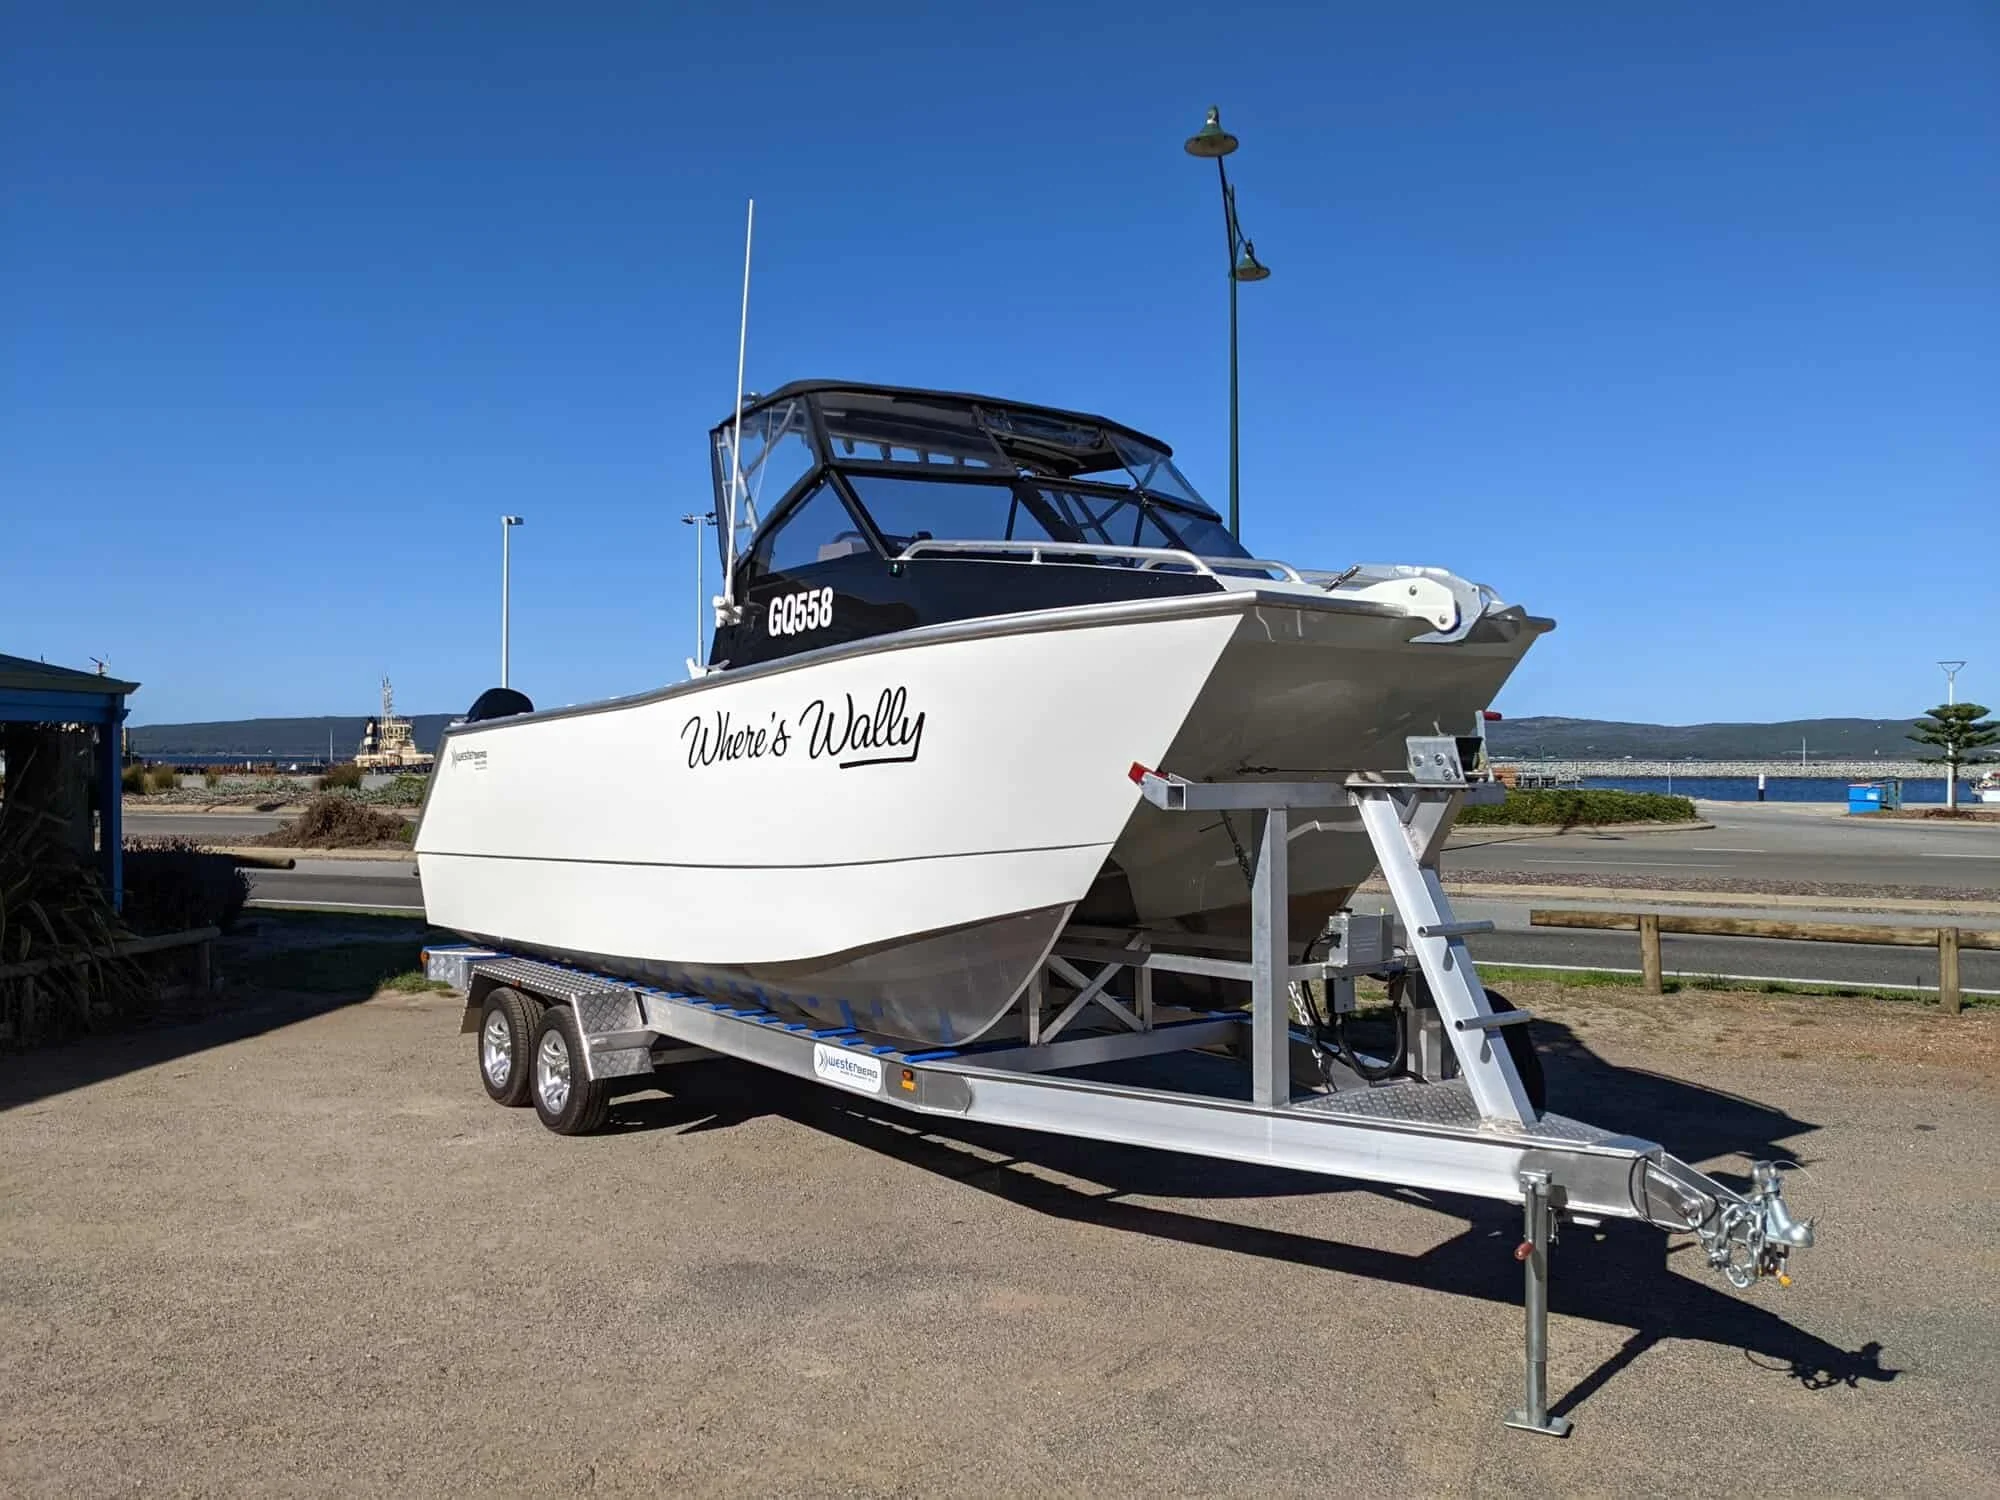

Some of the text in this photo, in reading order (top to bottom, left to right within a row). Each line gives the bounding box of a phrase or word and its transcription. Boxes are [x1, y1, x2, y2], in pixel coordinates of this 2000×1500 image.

[768, 586, 834, 637] GQ558
[681, 686, 926, 769] Where's Wally
